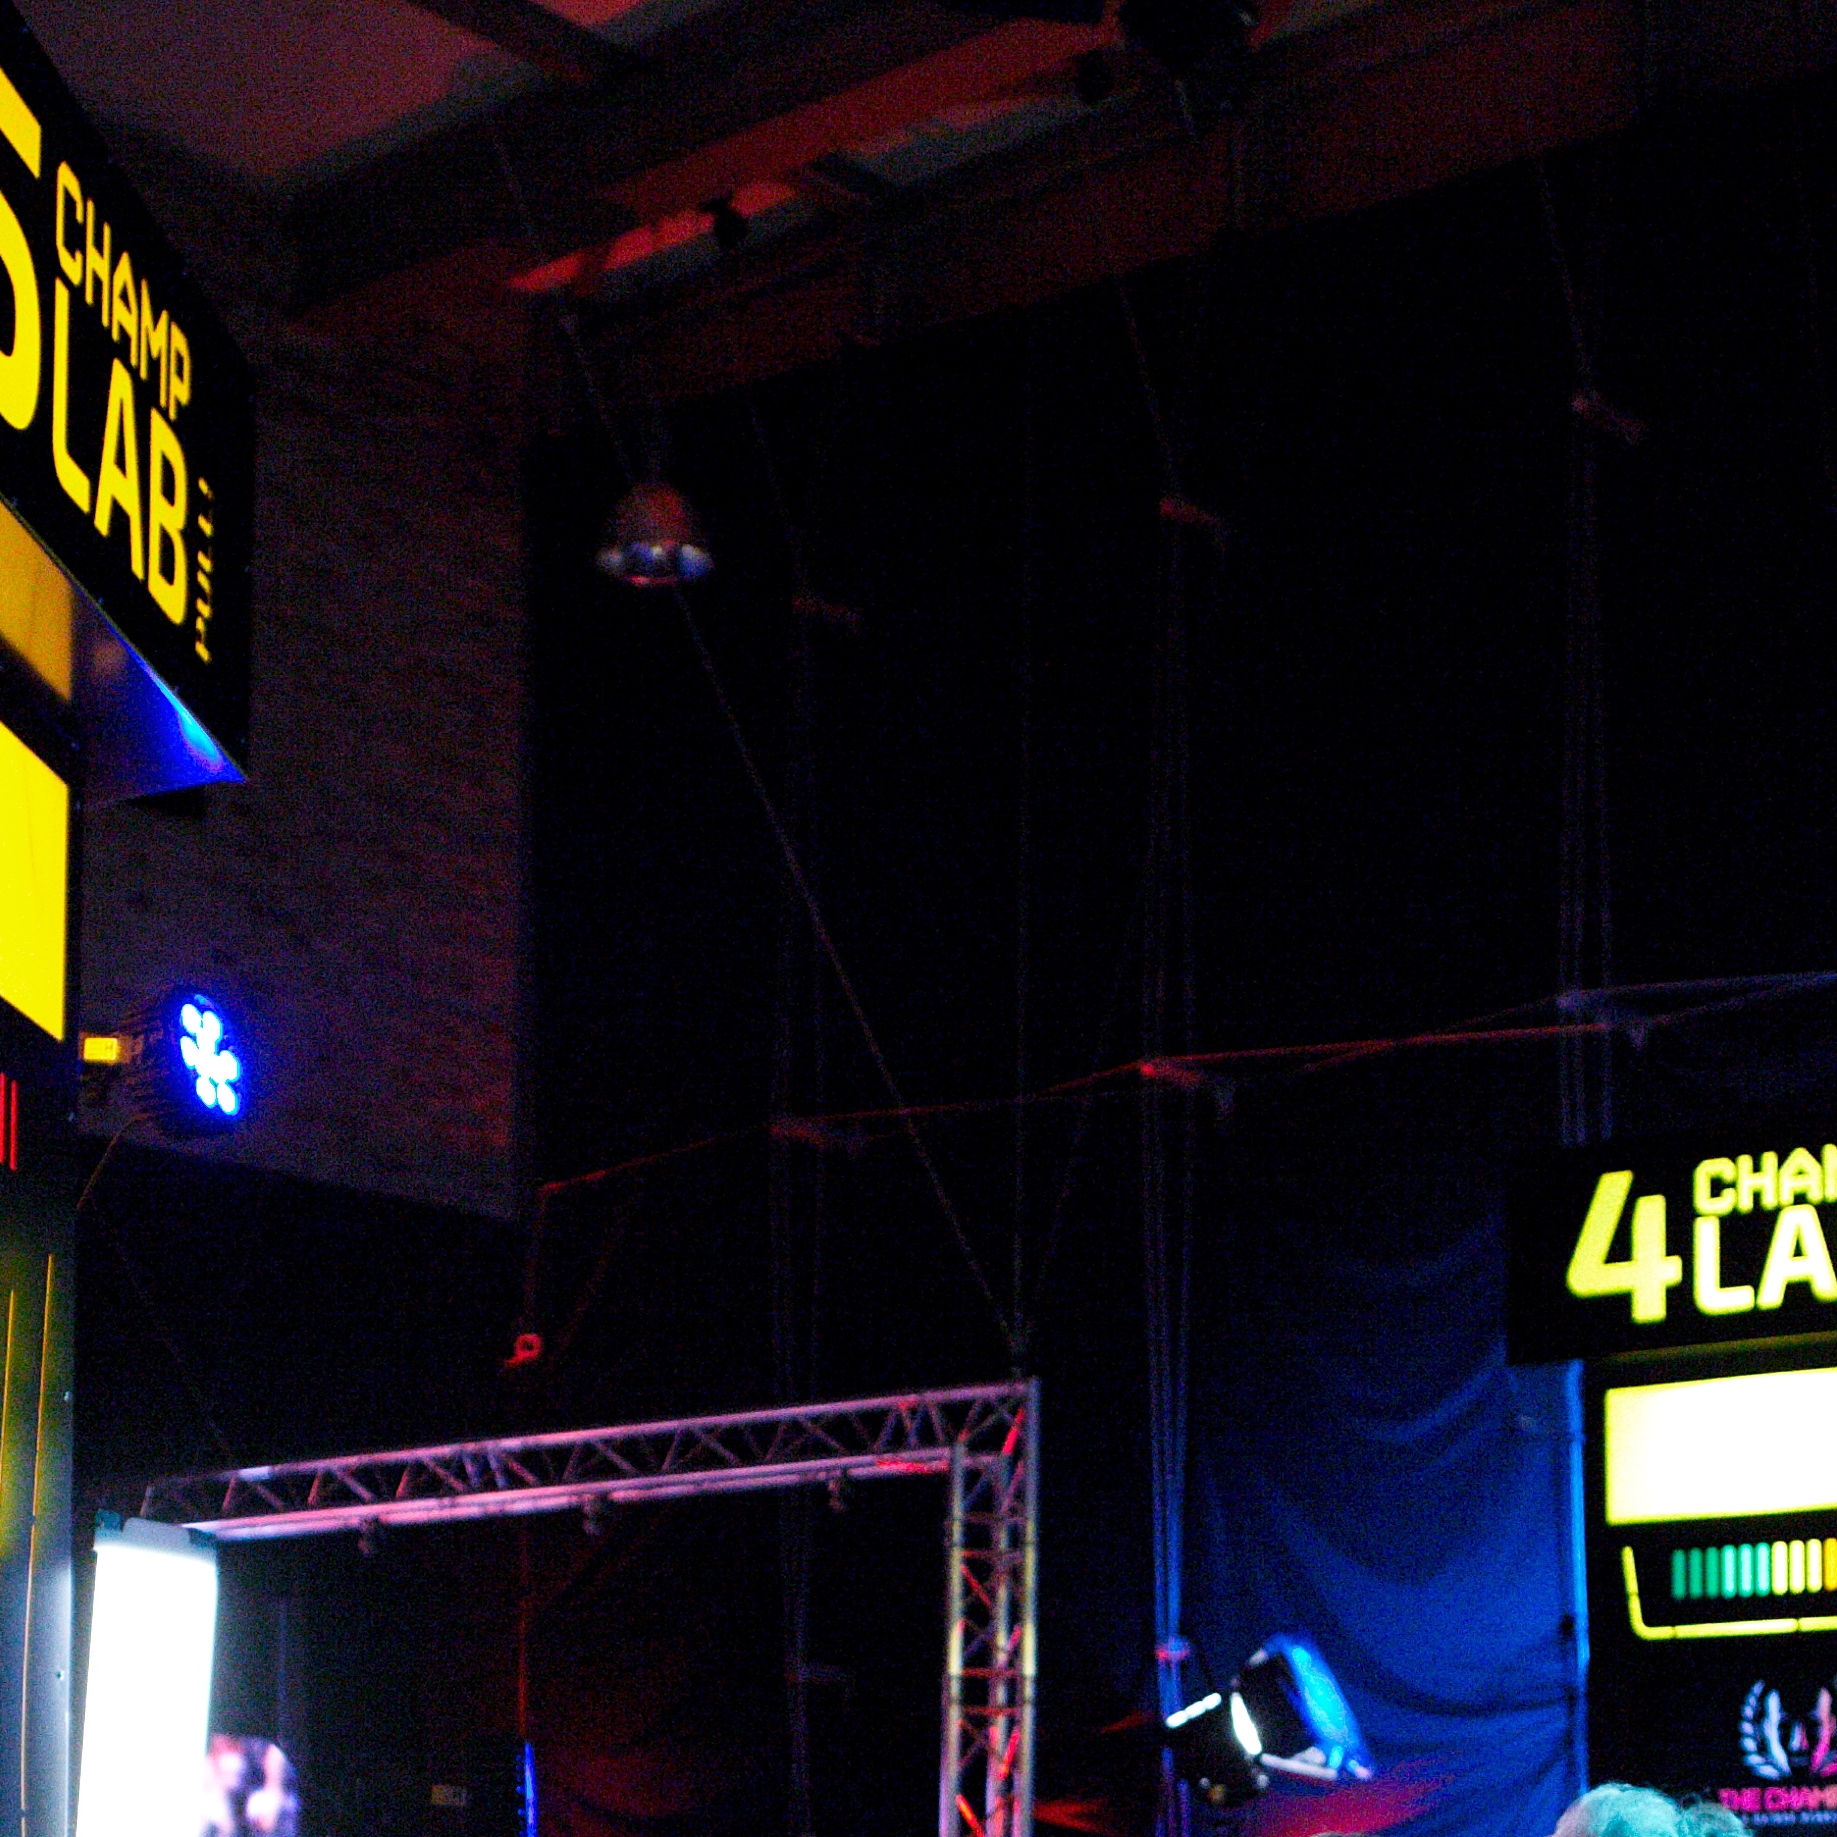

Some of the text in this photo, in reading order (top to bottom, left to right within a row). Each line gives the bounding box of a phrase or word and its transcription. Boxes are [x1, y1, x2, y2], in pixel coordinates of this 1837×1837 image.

[56, 161, 191, 420] CHAMP
[52, 277, 188, 624] LAB
[1566, 1170, 1683, 1324] 4
